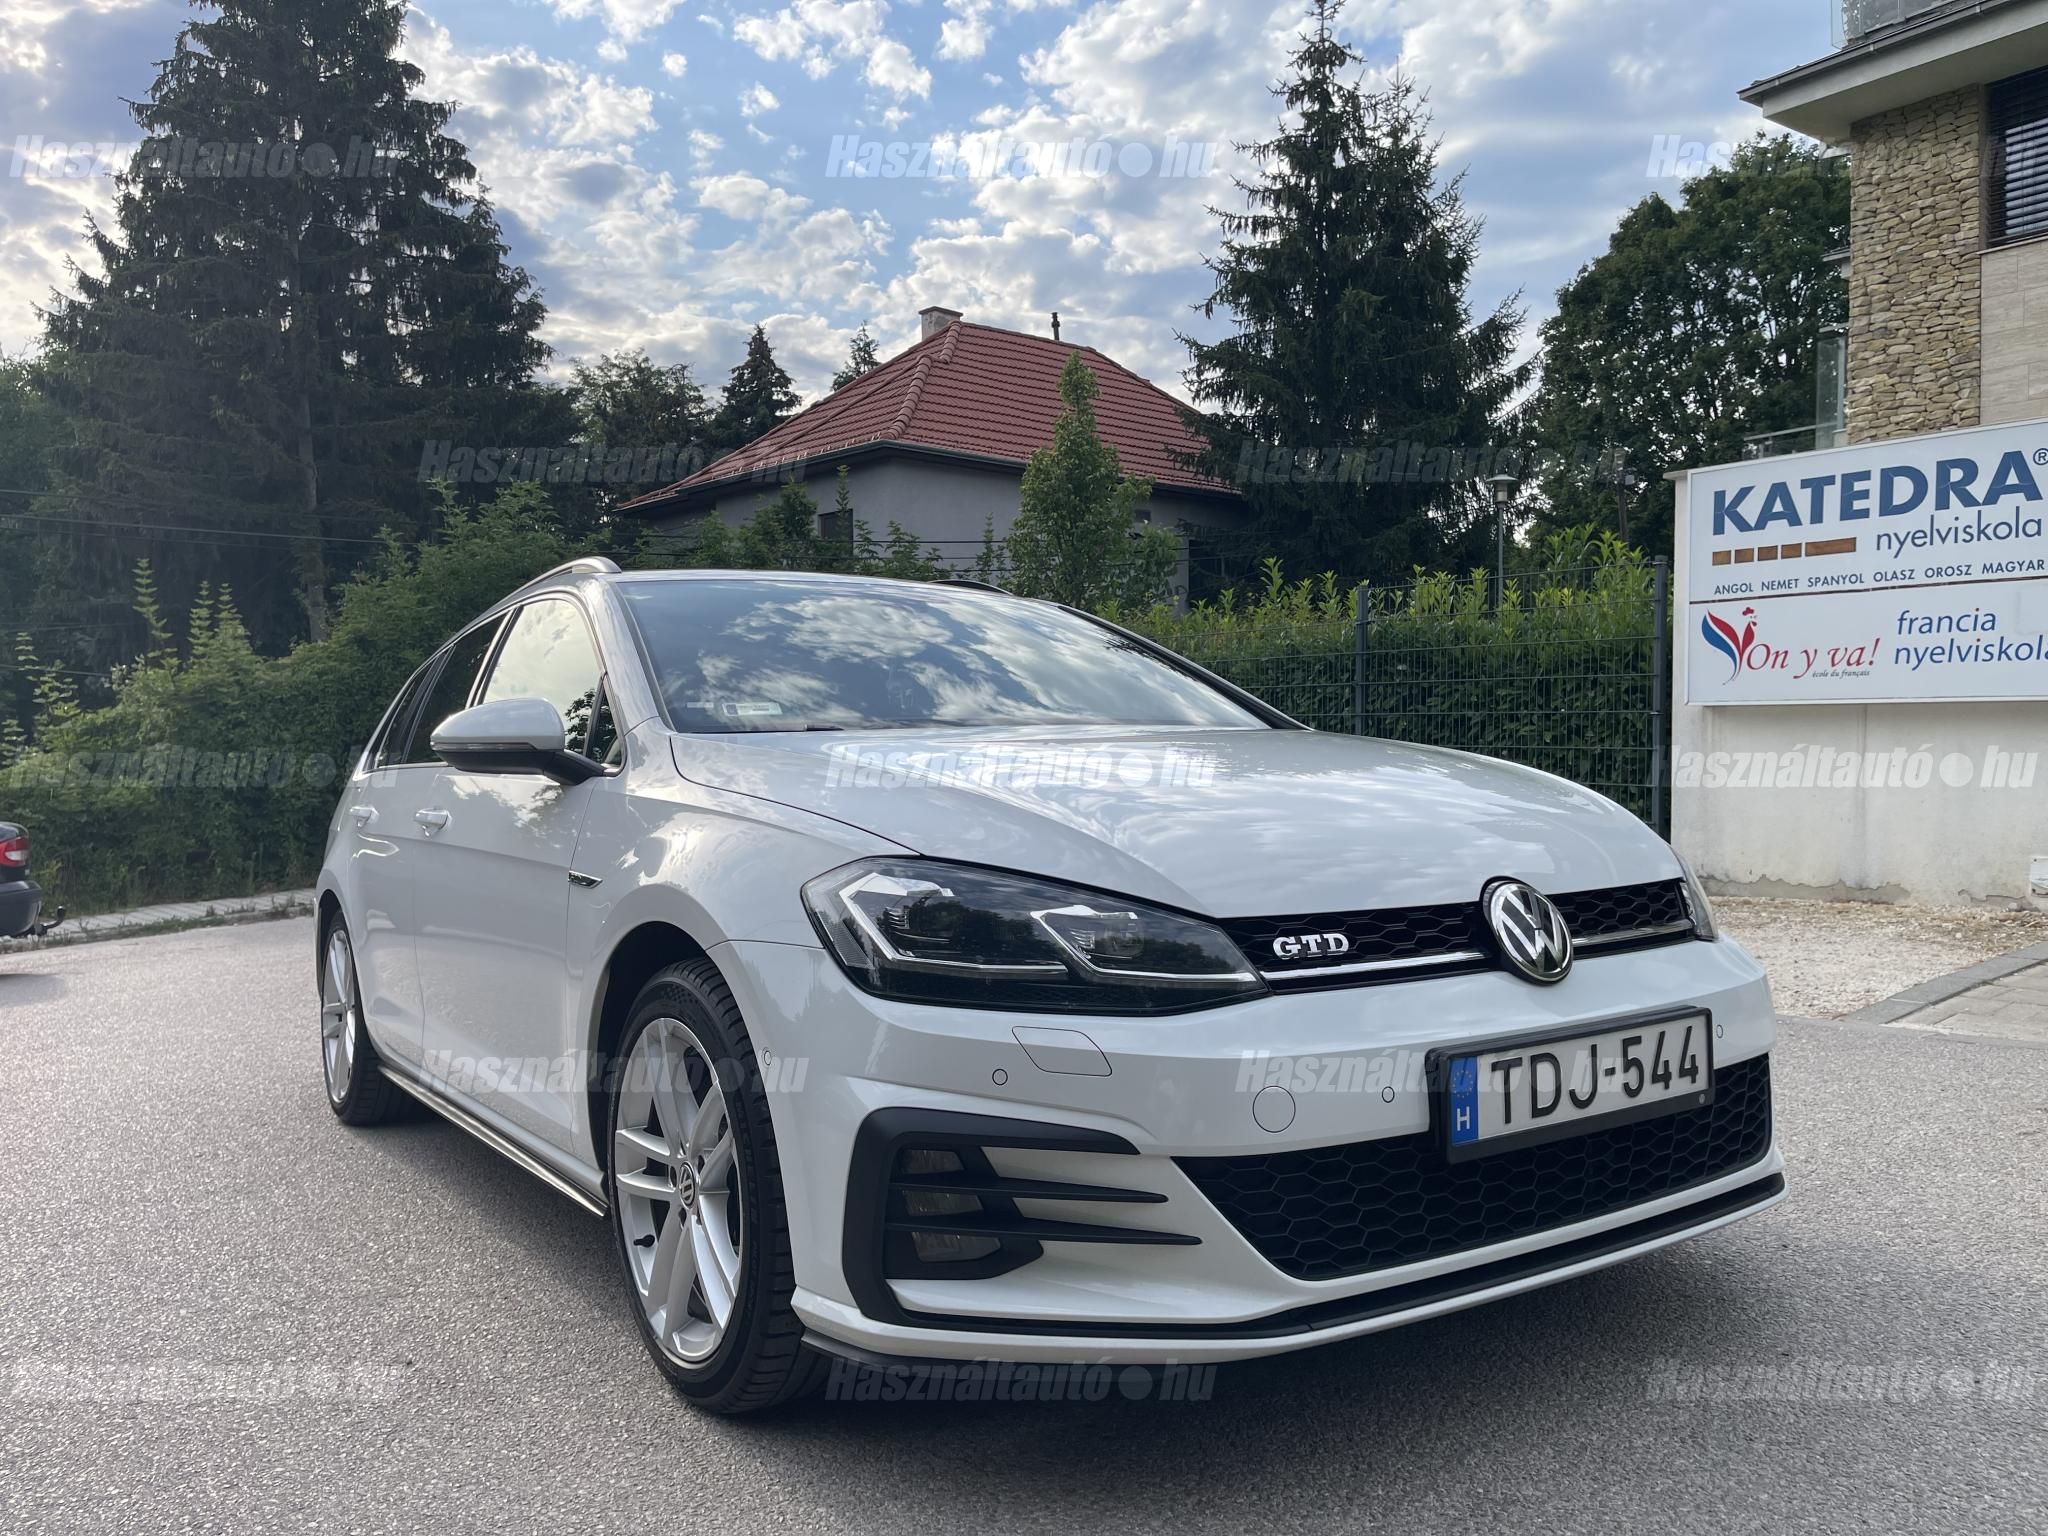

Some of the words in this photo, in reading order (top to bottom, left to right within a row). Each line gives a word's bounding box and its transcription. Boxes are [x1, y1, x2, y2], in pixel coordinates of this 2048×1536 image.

[1876, 506, 2042, 559] nyelviskola
[1714, 583, 1753, 595] ANGOL
[1761, 578, 1799, 591] NEMET
[1807, 573, 1864, 587] SPANYOL
[1873, 569, 1915, 583] OLASZ
[1924, 564, 1972, 579] OROSZ
[1982, 559, 2045, 575] MAGYAR
[1897, 607, 1996, 636] francia
[1793, 648, 1817, 679] y
[1828, 637, 1880, 667] va!
[1894, 634, 2048, 671] nyelviskol
[1272, 933, 1349, 960] GTD
[1491, 1026, 1699, 1125] TDJ-544
[1456, 1106, 1471, 1131] H
